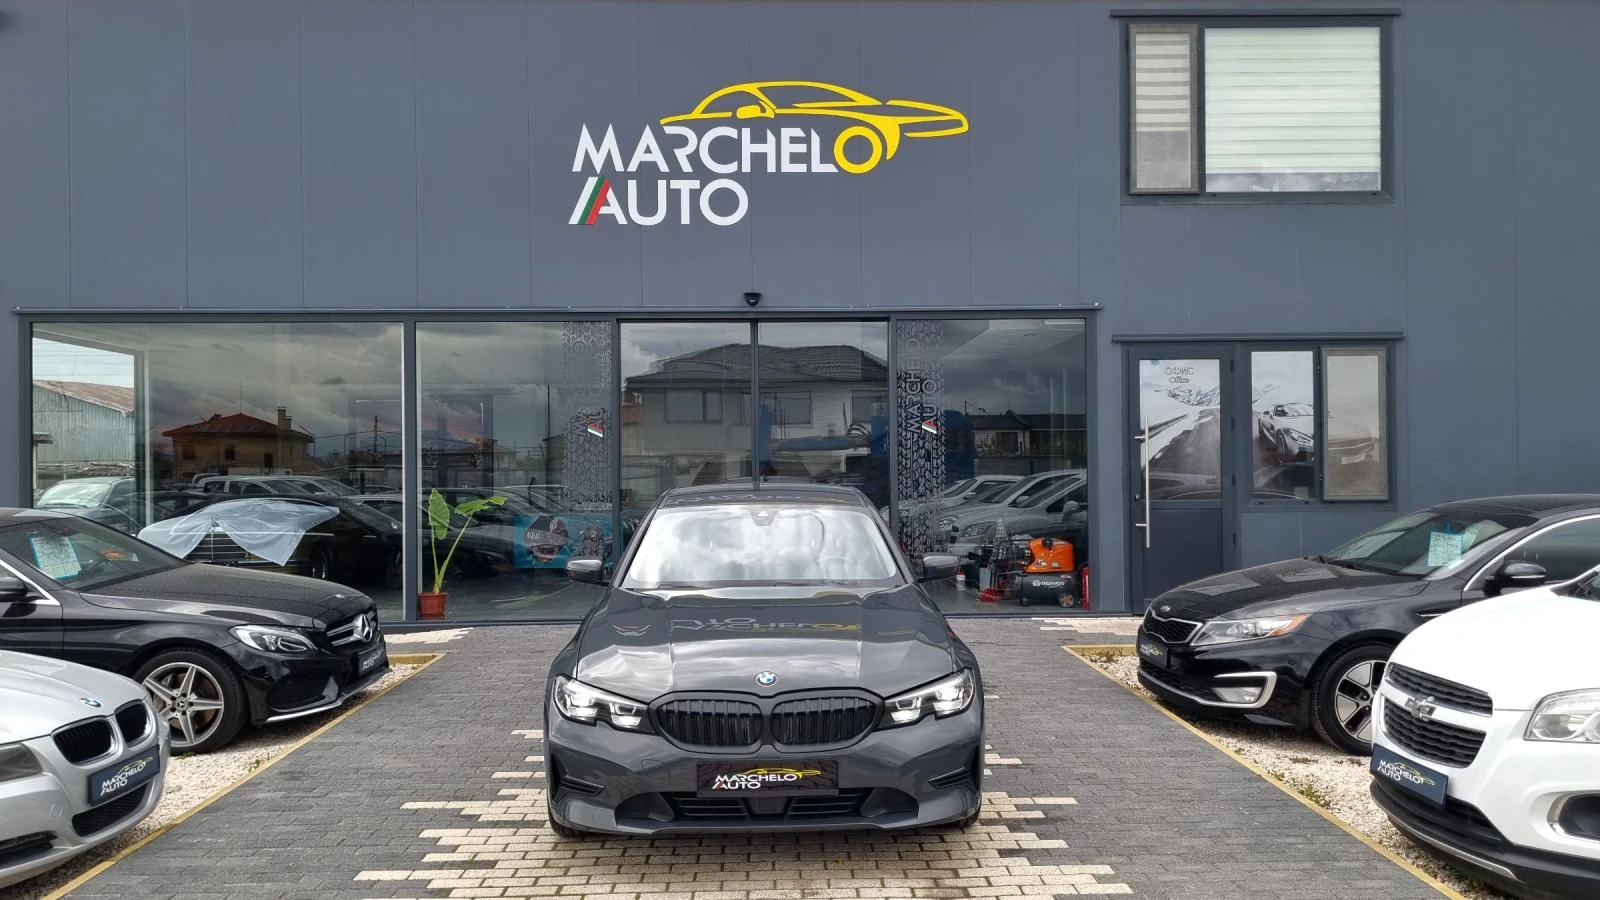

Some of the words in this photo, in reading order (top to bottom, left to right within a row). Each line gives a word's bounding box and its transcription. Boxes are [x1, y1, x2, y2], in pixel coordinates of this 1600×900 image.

[571, 123, 883, 175] MARCHELO
[568, 177, 749, 226] AUTO
[906, 337, 921, 433] MARCHELO
[921, 379, 938, 435] AUTO
[102, 764, 144, 789] MARCHELO
[714, 773, 798, 783] MARCHELO
[1377, 766, 1401, 781] AUTO
[1379, 759, 1421, 784] MARCHELO
[100, 780, 128, 796] AUTO
[711, 781, 761, 790] AUTO
